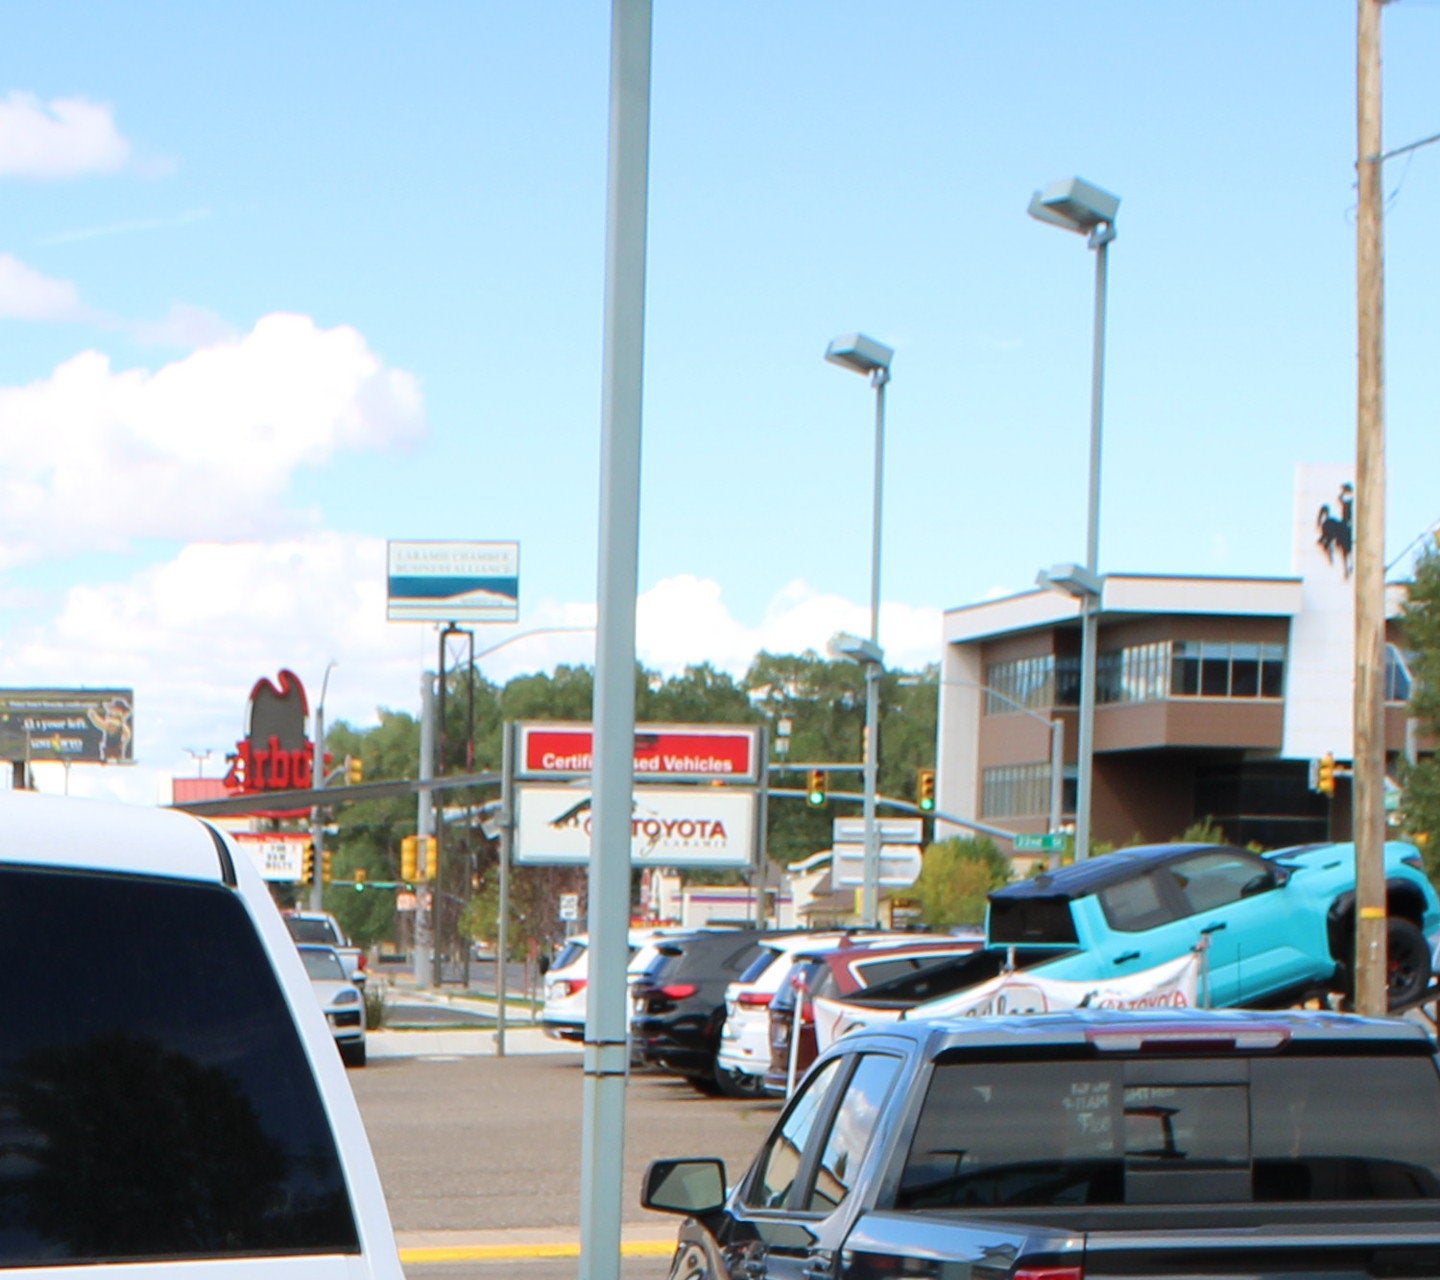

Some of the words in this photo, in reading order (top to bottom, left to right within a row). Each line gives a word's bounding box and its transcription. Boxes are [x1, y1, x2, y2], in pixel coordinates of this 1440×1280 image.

[224, 735, 333, 788] Arby
[542, 752, 593, 770] Certifi
[632, 756, 660, 771] sed
[663, 756, 733, 773] Vehicles
[632, 819, 727, 839] TOYOTA
